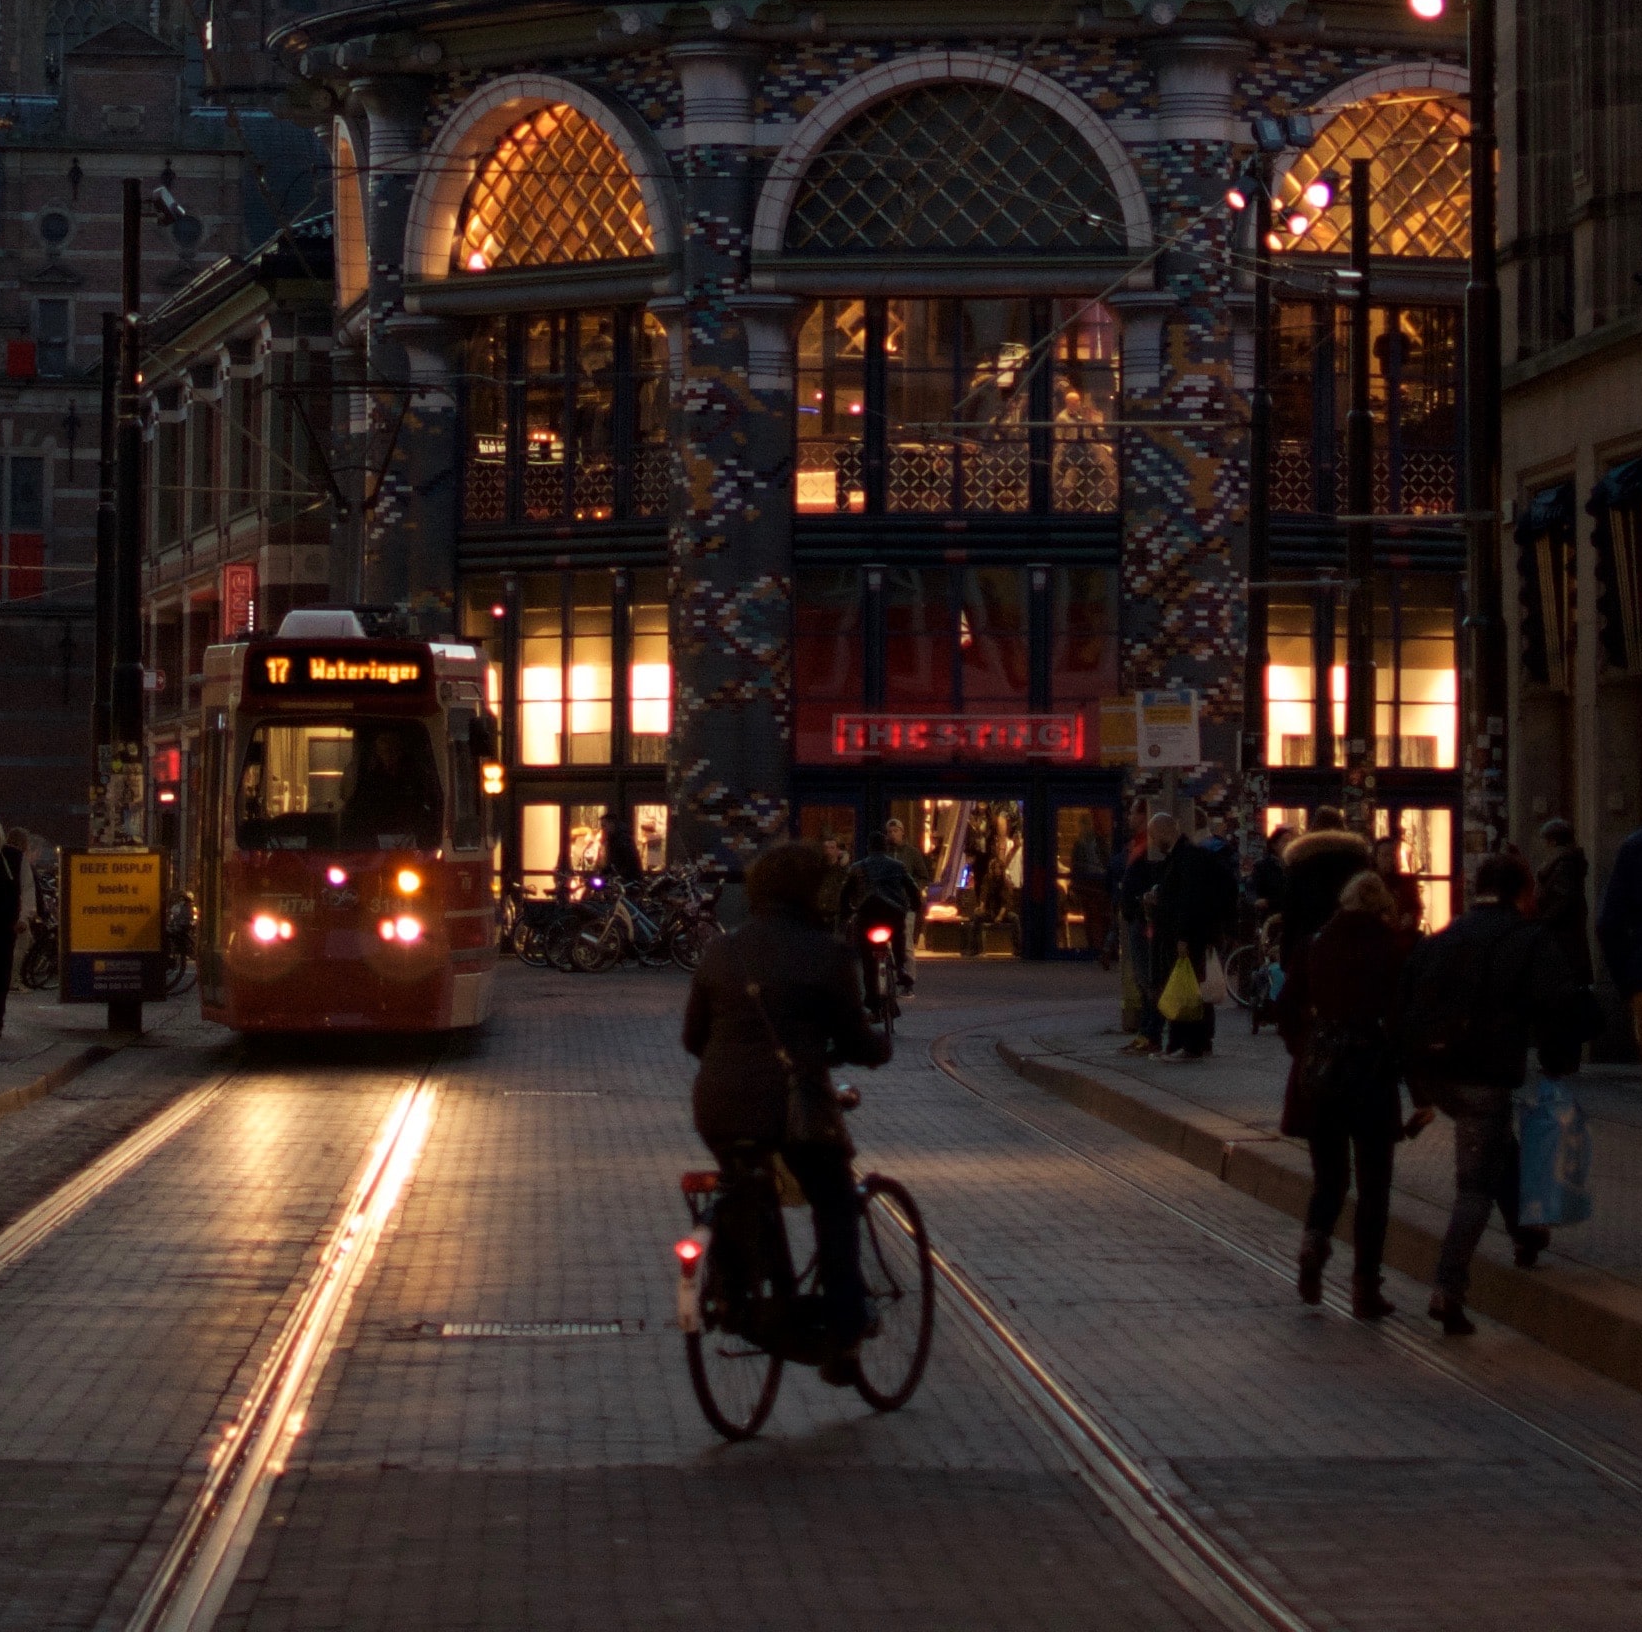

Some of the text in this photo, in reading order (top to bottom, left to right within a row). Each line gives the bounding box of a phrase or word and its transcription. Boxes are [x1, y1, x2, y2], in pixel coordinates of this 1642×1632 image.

[266, 657, 290, 683] 17
[846, 723, 1066, 747] THE STING
[112, 863, 153, 874] DISPLAY
